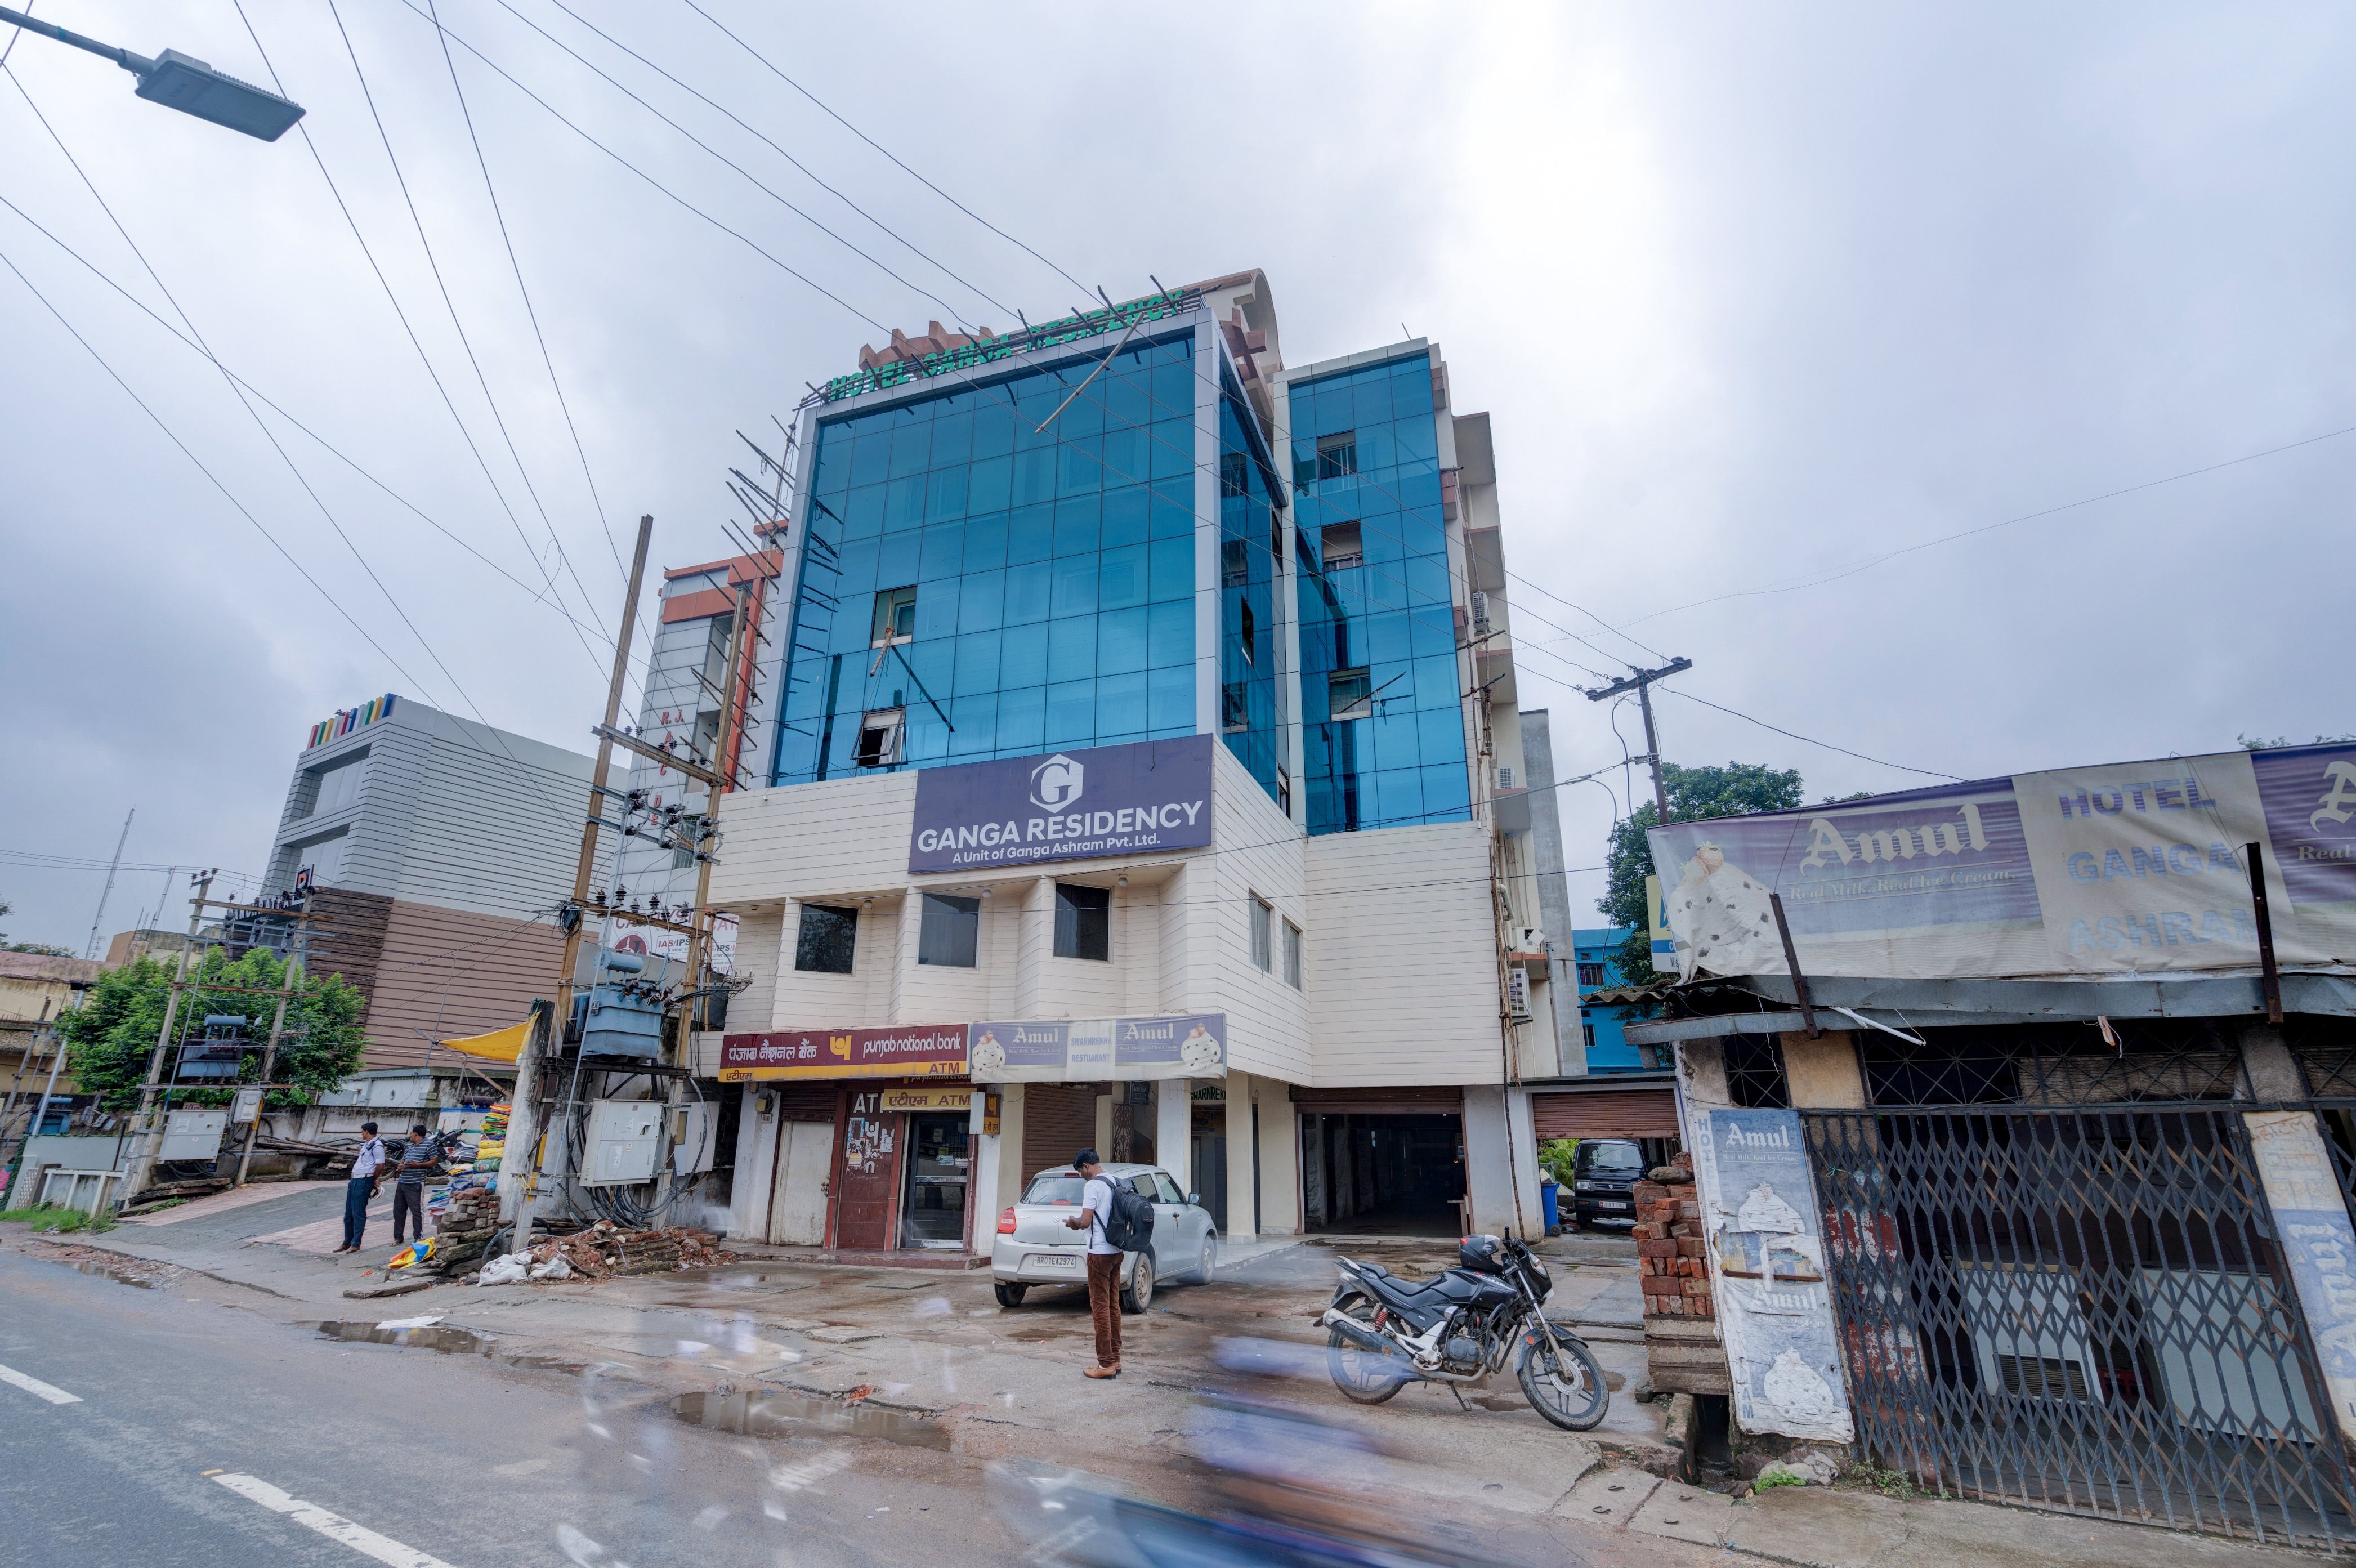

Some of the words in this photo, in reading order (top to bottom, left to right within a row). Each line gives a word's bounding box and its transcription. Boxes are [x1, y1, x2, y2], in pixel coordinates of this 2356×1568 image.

[830, 361, 910, 401] HOTEL
[922, 334, 1012, 378] GANGA
[1026, 289, 1184, 352] RESIDENCY
[2058, 778, 2216, 820] HOTEL
[918, 820, 1021, 853] GANGA
[1026, 800, 1203, 842] RESIDENCY
[952, 854, 962, 864] A
[964, 850, 989, 863] Unit
[992, 848, 1005, 860] of
[1007, 845, 1050, 859] Ganga
[1052, 839, 1103, 854] Ashram
[1107, 836, 1133, 849] Pvt.
[1135, 833, 1160, 846] Ltd.
[1800, 803, 1991, 877] Amul
[2067, 841, 2244, 885] GANGA
[2297, 844, 2351, 861] Real
[1790, 884, 1825, 900] Real
[1831, 881, 1871, 896] Milk.
[1877, 877, 1914, 892] Real
[1919, 875, 1944, 888] Ice
[1950, 871, 2016, 884] Cream.
[1012, 1026, 1059, 1044] Amul
[1071, 1037, 1112, 1046] SWARNREKHA
[1124, 1022, 1174, 1042] Amul
[729, 1043, 758, 1061] पंजाब
[760, 1039, 795, 1062] नैशनल
[798, 1038, 817, 1059] बैंक
[863, 1035, 896, 1059] punjab
[897, 1033, 936, 1052] national
[937, 1031, 961, 1051] bank
[929, 1062, 960, 1074] ATM
[1072, 1053, 1110, 1062] RESTUARANT
[726, 1070, 753, 1081] एटीएम
[888, 1092, 929, 1106] एटीएम
[938, 1095, 970, 1105] ATM
[1190, 1085, 1226, 1100] SWARNREK
[1726, 1123, 1790, 1149] Amul
[1751, 1282, 1818, 1311] Amul
